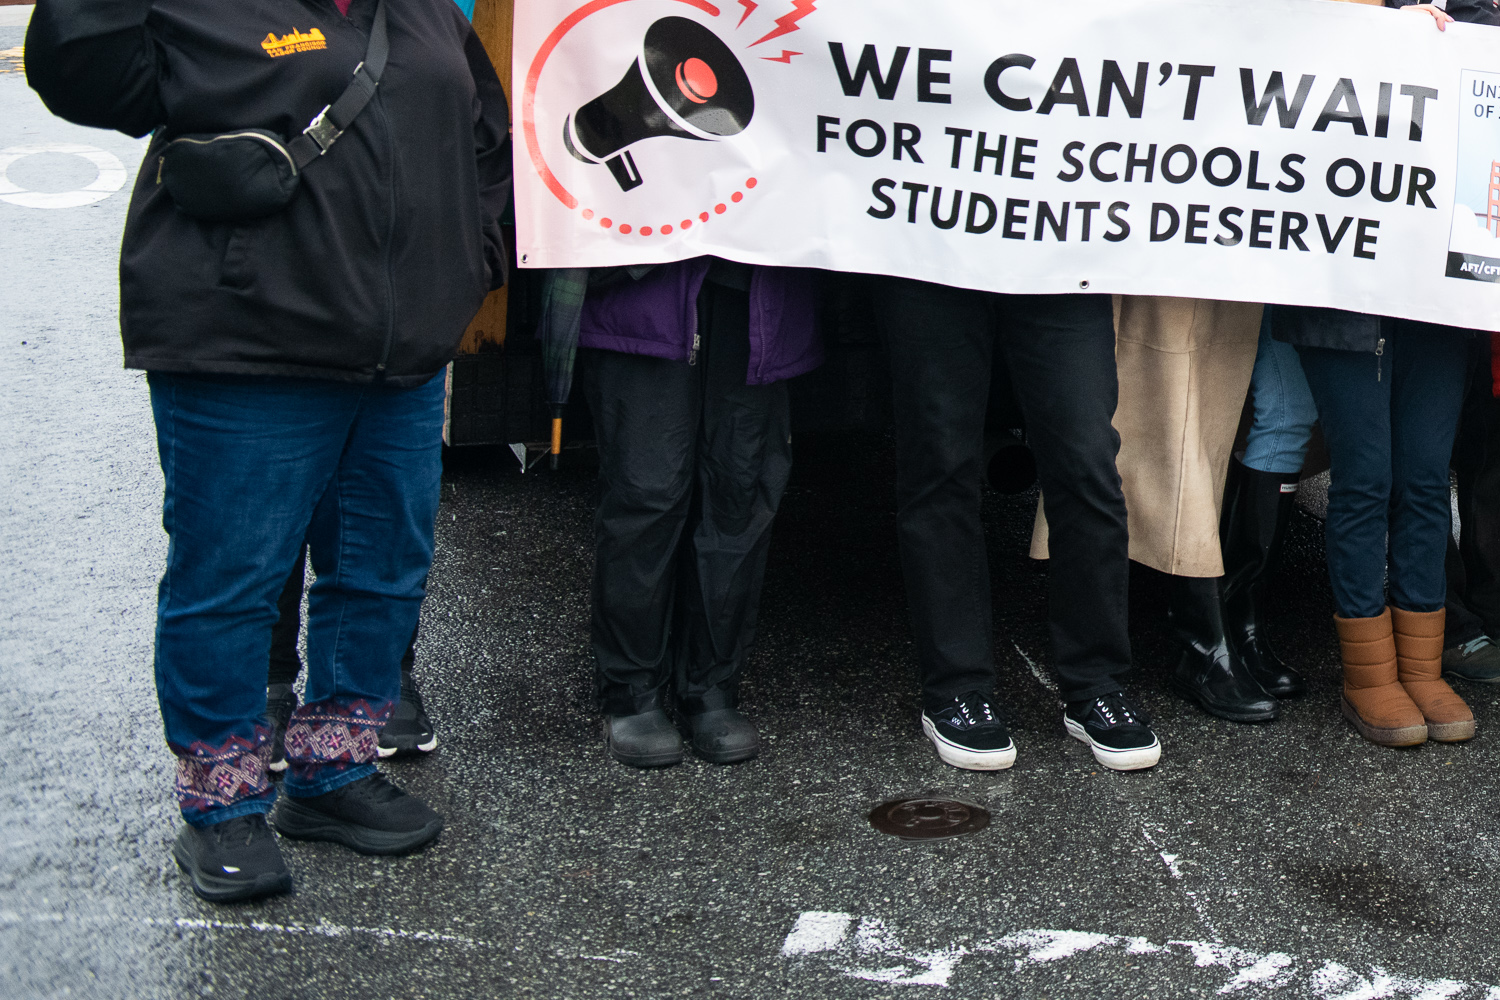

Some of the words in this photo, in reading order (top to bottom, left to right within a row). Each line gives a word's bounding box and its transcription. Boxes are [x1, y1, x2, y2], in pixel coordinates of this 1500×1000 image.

[827, 41, 952, 104] WE
[984, 53, 1216, 121] CAN'T
[1239, 67, 1438, 142] WAIT
[817, 114, 924, 164] FOR
[945, 126, 1038, 180] THE
[1056, 140, 1306, 193] SCHOOLS
[1325, 157, 1437, 209] OUR
[866, 178, 1131, 242] STUDENTS
[1149, 202, 1380, 260] DESERVE
